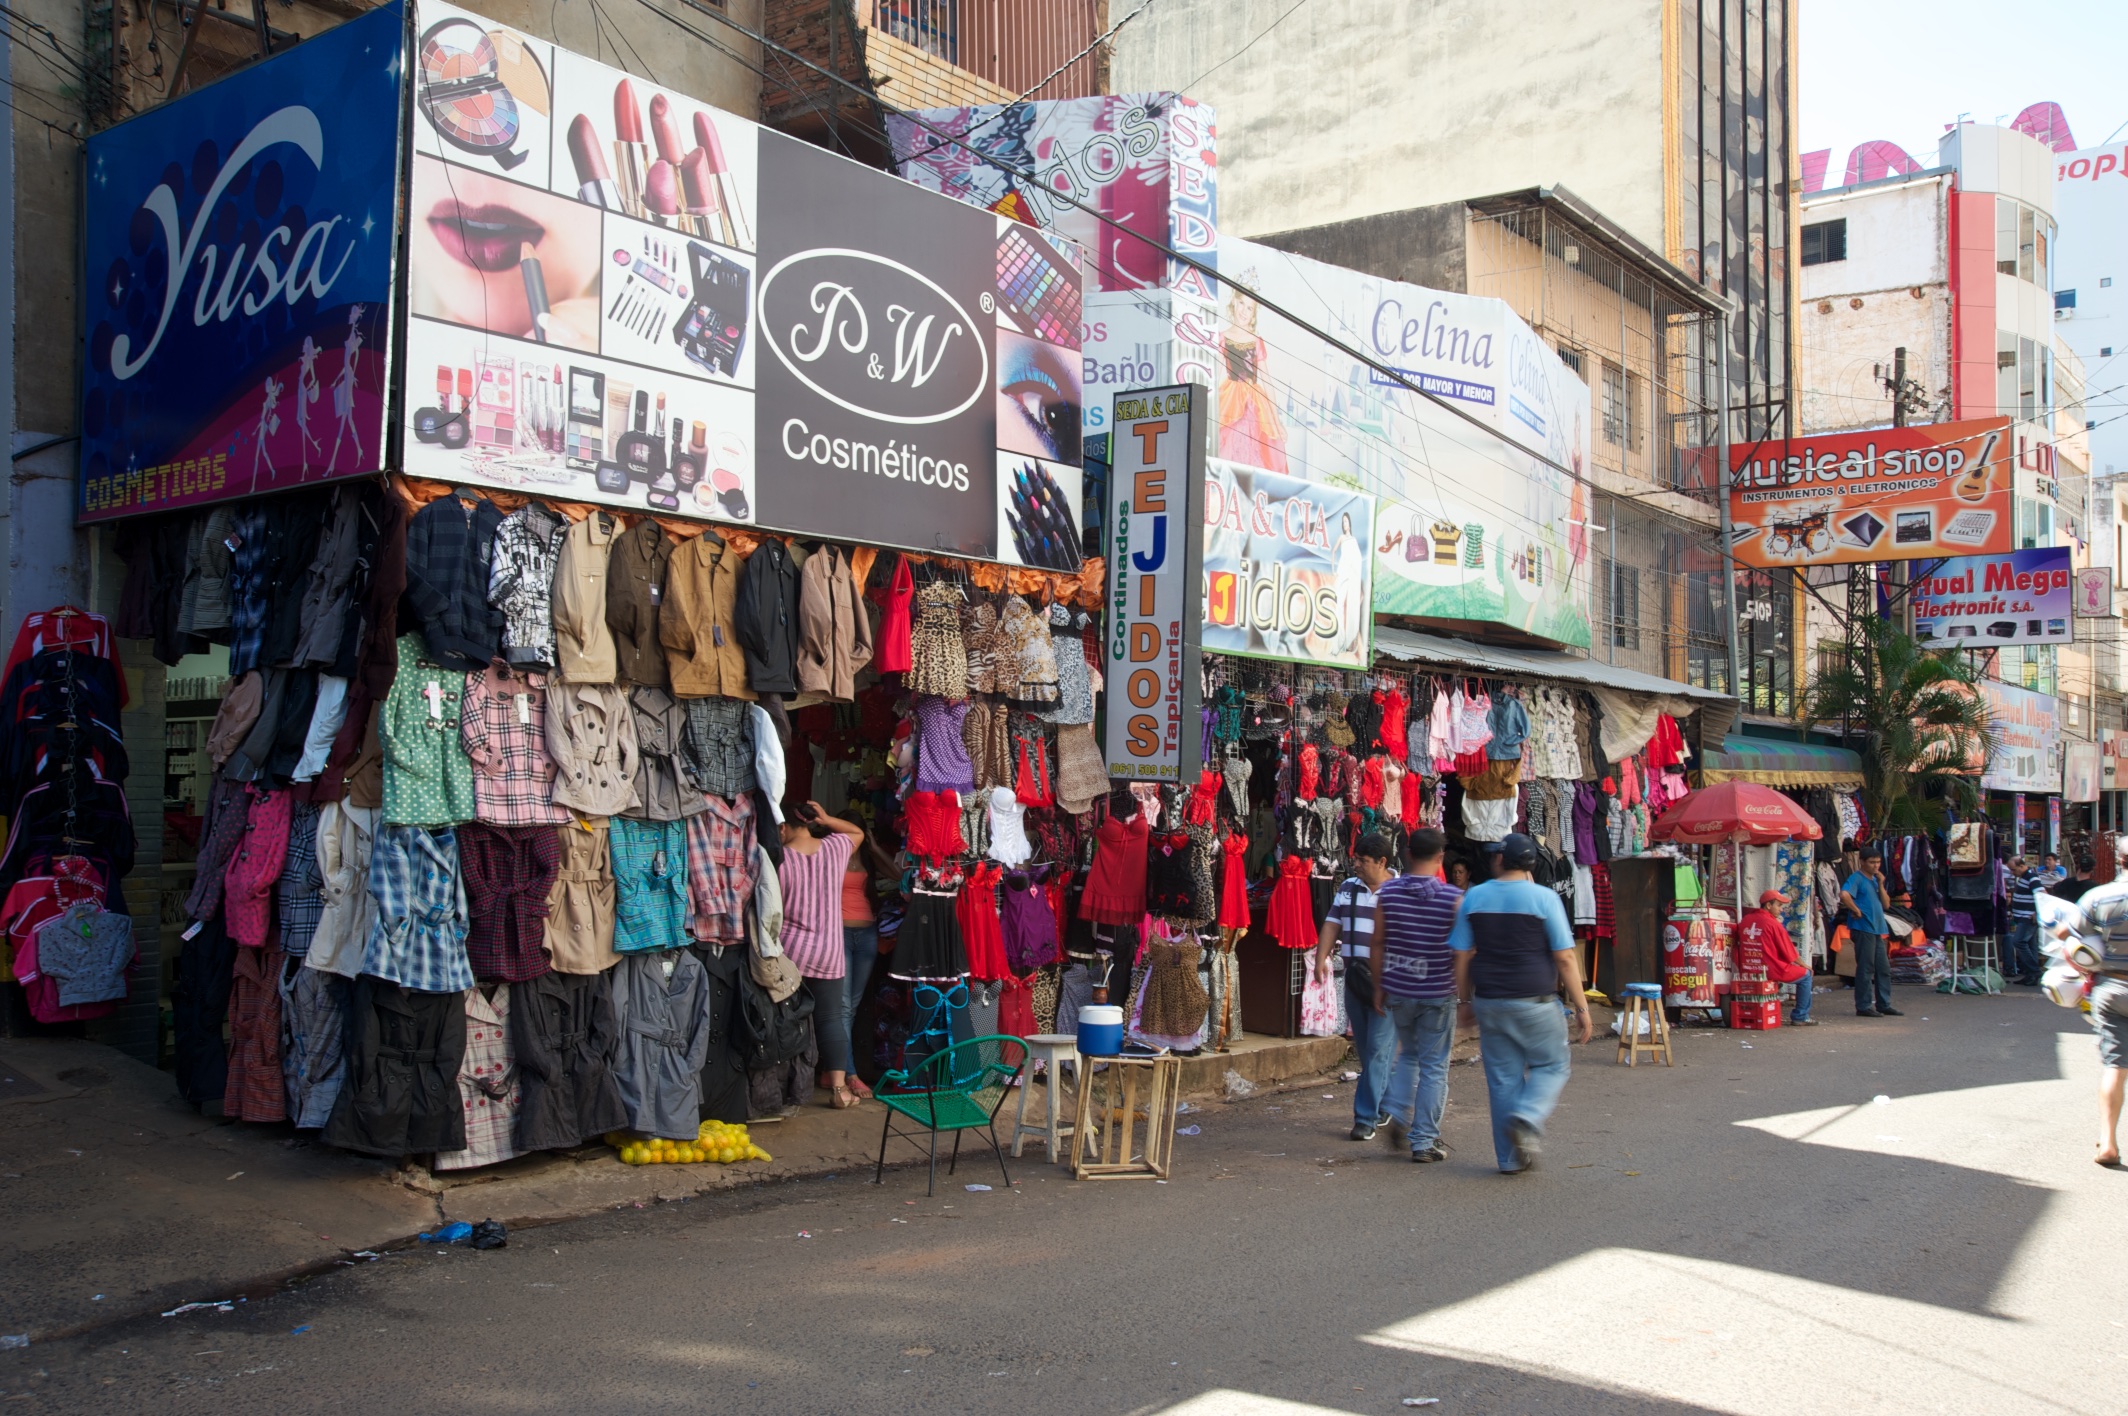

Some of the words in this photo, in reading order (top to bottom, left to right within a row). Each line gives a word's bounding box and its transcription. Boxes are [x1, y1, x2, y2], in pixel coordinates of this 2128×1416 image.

[111, 105, 356, 380] Yusa
[1372, 299, 1494, 369] Celina
[1082, 356, 1155, 385] Baño
[1423, 376, 1454, 395] MAYOR
[1455, 383, 1462, 396] Y
[1462, 385, 1493, 402] MENOR
[1116, 399, 1149, 421] SEDA
[1151, 397, 1163, 417] &
[1165, 393, 1189, 415] CIA
[86, 453, 227, 512] COSMETICOS
[782, 418, 970, 492] Cosméticos
[1742, 486, 1834, 503] INSTRUMENTOS
[1837, 485, 1847, 496] &
[1850, 478, 1938, 495] ELETRONICOS
[1251, 491, 1277, 538] &
[1283, 498, 1330, 549] CIA
[1112, 499, 1130, 661] Cortinados
[1126, 420, 1169, 758] TEJIDOS
[1914, 595, 2007, 618] Electronic
[2011, 601, 2035, 613] S.A.
[1983, 562, 2069, 597] Mega
[1163, 620, 1182, 757] Tapiçaria
[1109, 763, 1136, 777] (061)
[1138, 764, 1157, 776] 509
